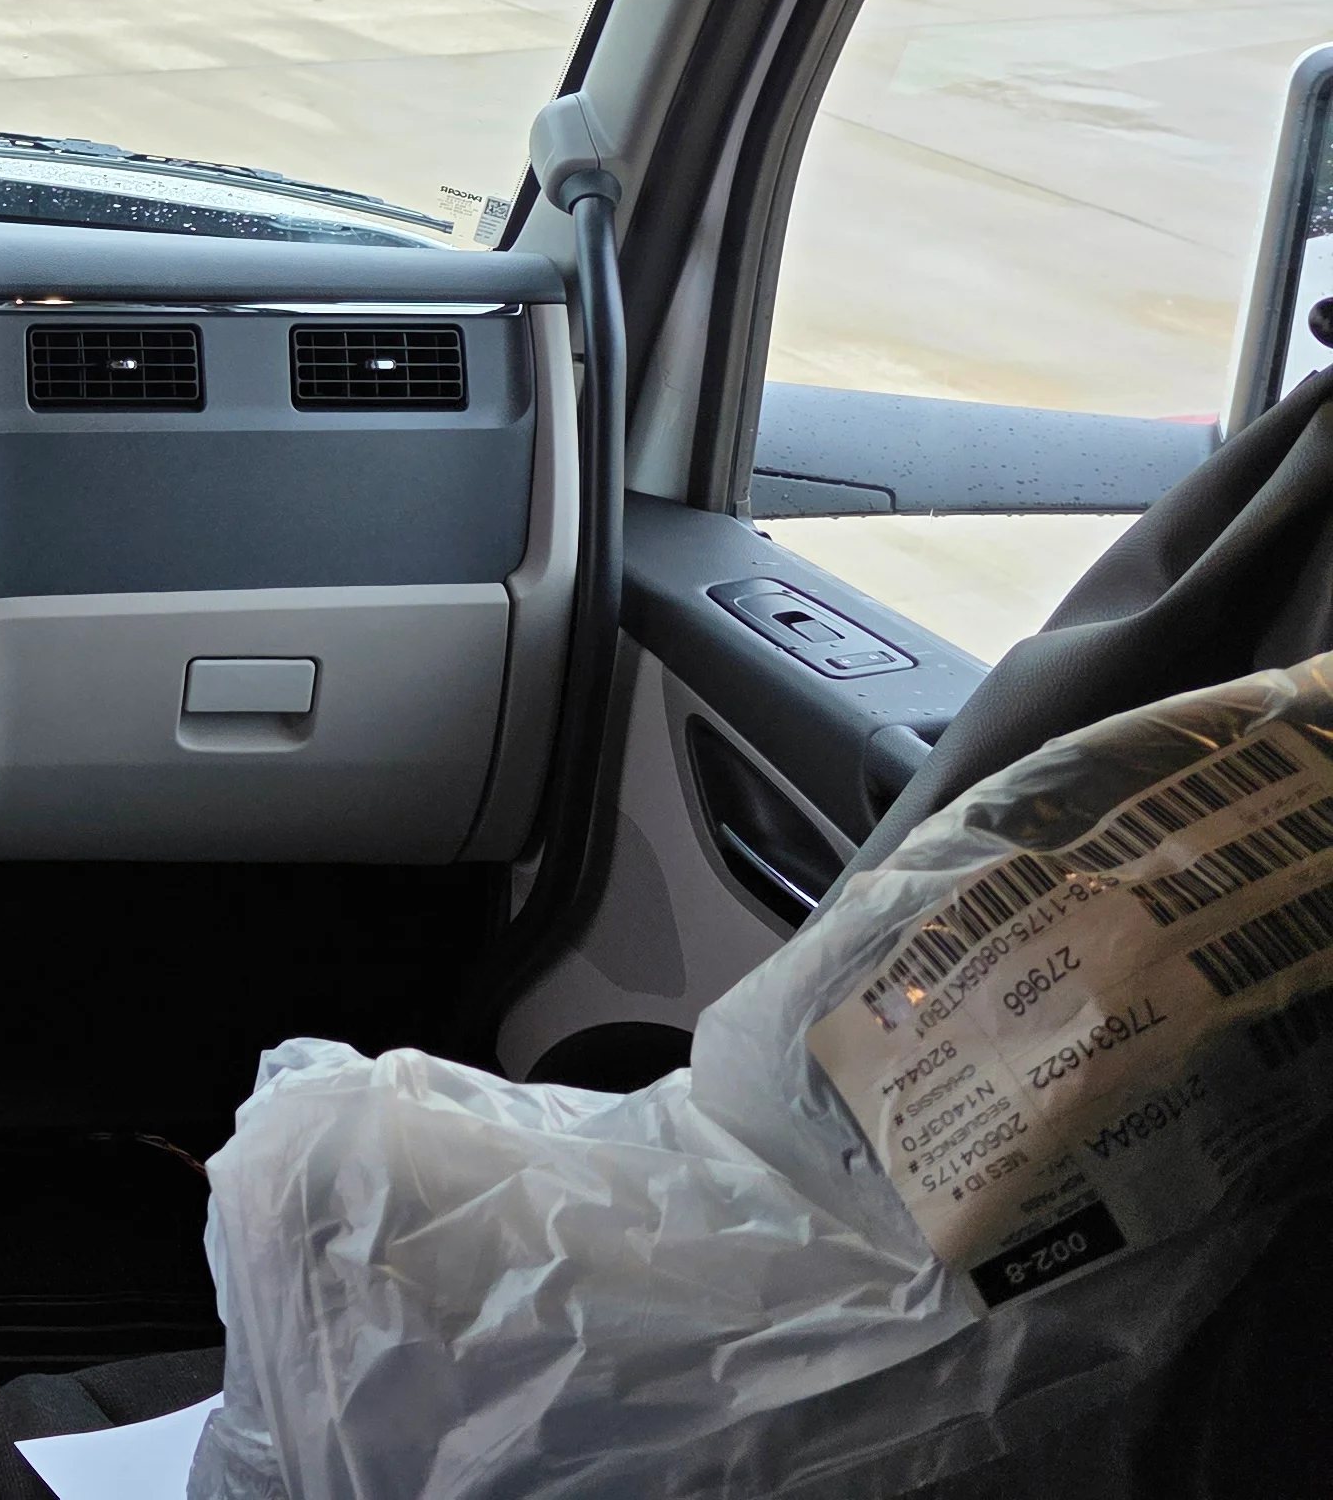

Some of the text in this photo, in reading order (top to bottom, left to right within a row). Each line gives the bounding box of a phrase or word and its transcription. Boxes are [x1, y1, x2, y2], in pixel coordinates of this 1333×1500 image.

[1000, 945, 1083, 1020] 27966
[1025, 993, 1168, 1092] 77631622
[892, 1062, 978, 1128] CHASSIS #
[899, 1079, 996, 1154] N1403F0
[906, 1095, 1012, 1175] SEQUENCE #
[919, 1111, 1030, 1194] 20604175
[948, 1183, 967, 1204] #
[962, 1171, 988, 1195] ID
[1000, 1227, 1091, 1288] 002-8
